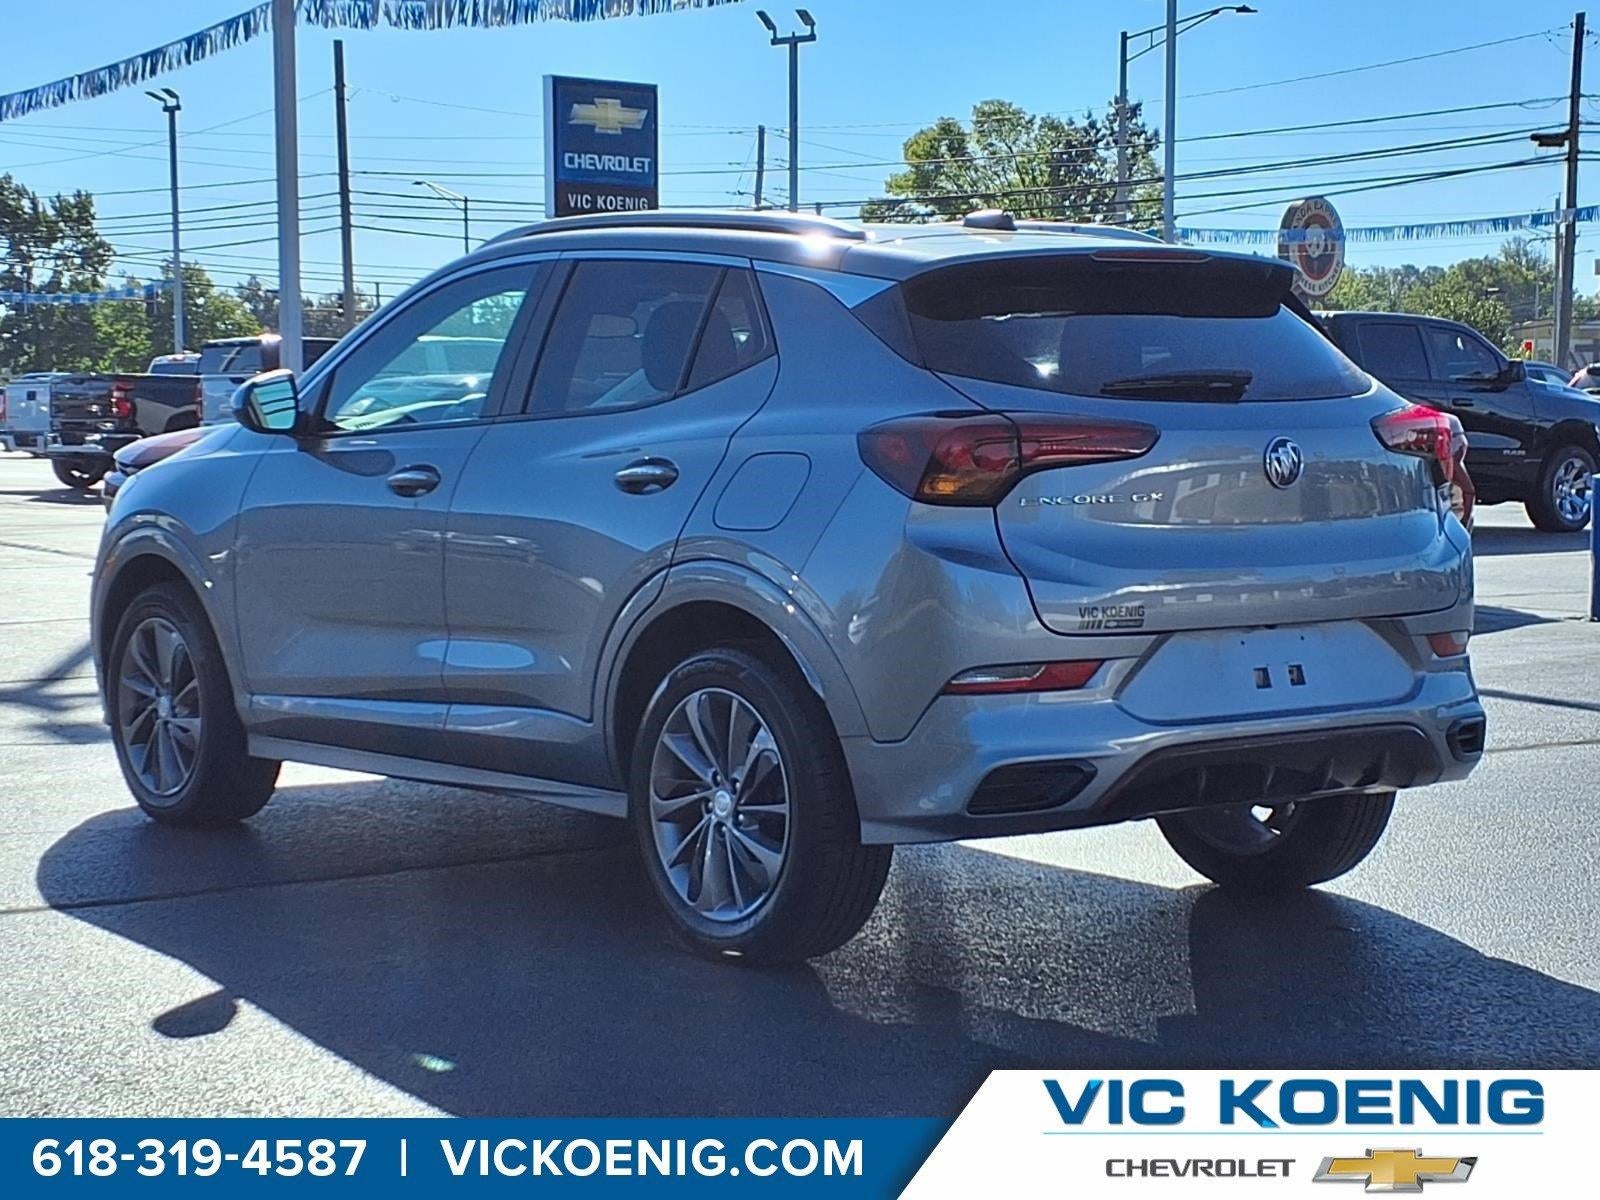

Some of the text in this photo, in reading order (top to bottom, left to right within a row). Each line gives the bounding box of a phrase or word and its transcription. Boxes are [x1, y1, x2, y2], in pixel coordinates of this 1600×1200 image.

[564, 152, 652, 174] CHEVROLET
[568, 193, 649, 211] VIC KOENIG
[1020, 491, 1163, 506] ENCORE GX
[1079, 605, 1145, 618] VIC KOENIG
